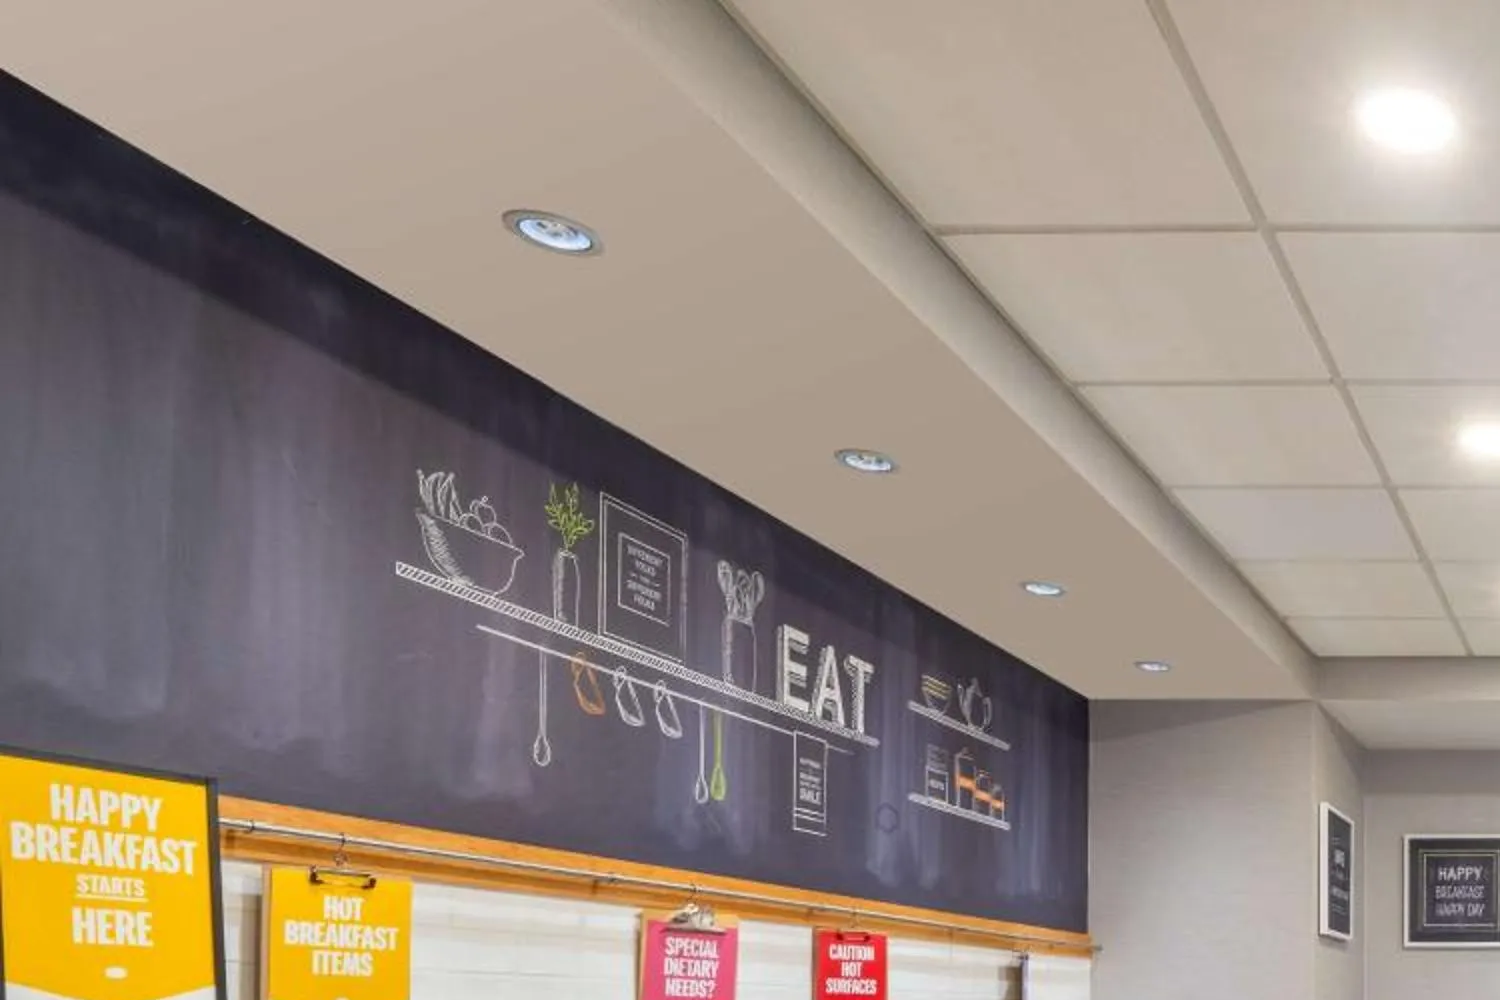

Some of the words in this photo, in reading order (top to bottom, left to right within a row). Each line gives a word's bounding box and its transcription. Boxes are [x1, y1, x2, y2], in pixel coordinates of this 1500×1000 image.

[776, 624, 875, 734] EAT
[50, 783, 162, 832] HAPPY
[10, 820, 197, 875] BREAKFAST
[76, 873, 145, 897] STARTS
[1438, 865, 1483, 881] HAPPY
[323, 895, 364, 921] HOT
[72, 907, 153, 947] HERE
[284, 919, 398, 951] BREAKFAST
[665, 937, 719, 959] SPECIAL
[829, 943, 875, 961] CAUTION
[312, 949, 373, 977] ITEMS
[664, 957, 720, 979] DIETARY
[841, 961, 862, 977] HOT
[665, 978, 716, 999] NEEDS?
[825, 977, 877, 995] SURFACES
